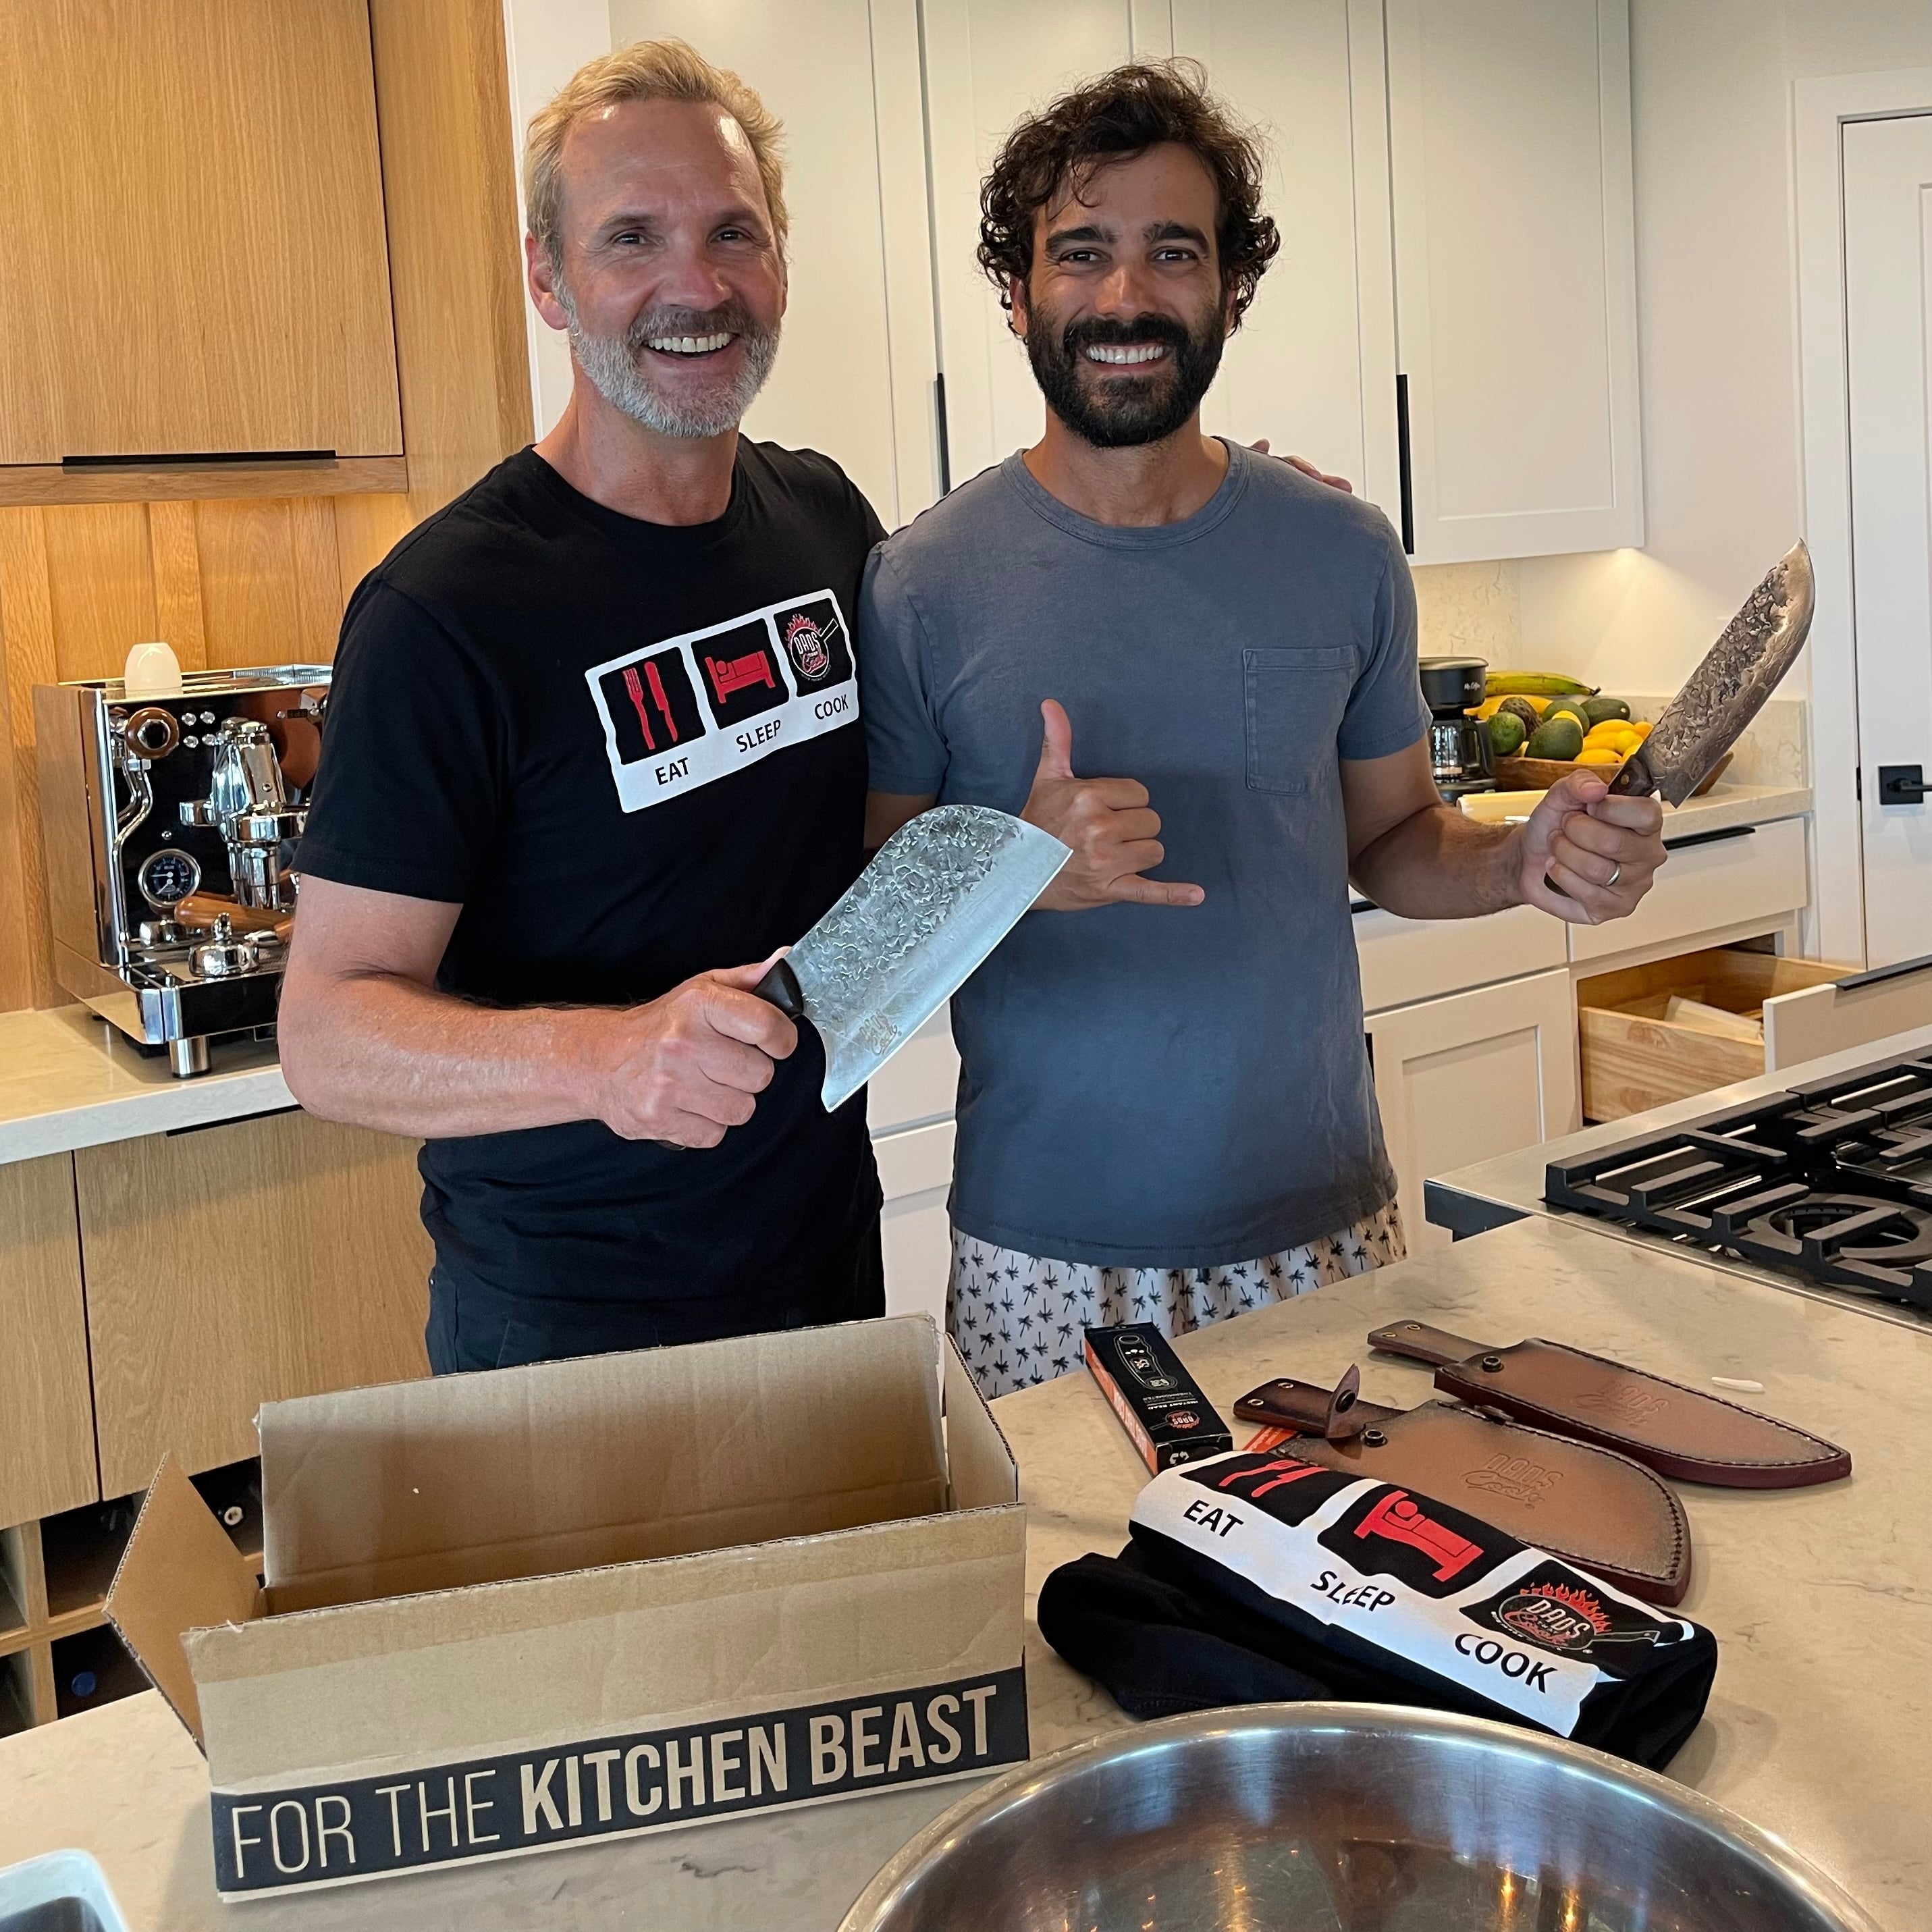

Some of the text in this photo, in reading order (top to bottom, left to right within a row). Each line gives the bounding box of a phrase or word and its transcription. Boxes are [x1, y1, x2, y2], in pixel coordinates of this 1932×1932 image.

[794, 631, 822, 655] DADS
[654, 693, 849, 786] EAT SLEEP COOK
[1483, 1453, 1563, 1488] DADS
[1183, 1499, 1244, 1538] EAT
[1455, 1633, 1558, 1694] COOK
[1526, 1599, 1590, 1638] DADS
[232, 1684, 997, 1879] FOR THE KITCHEN BEAST
